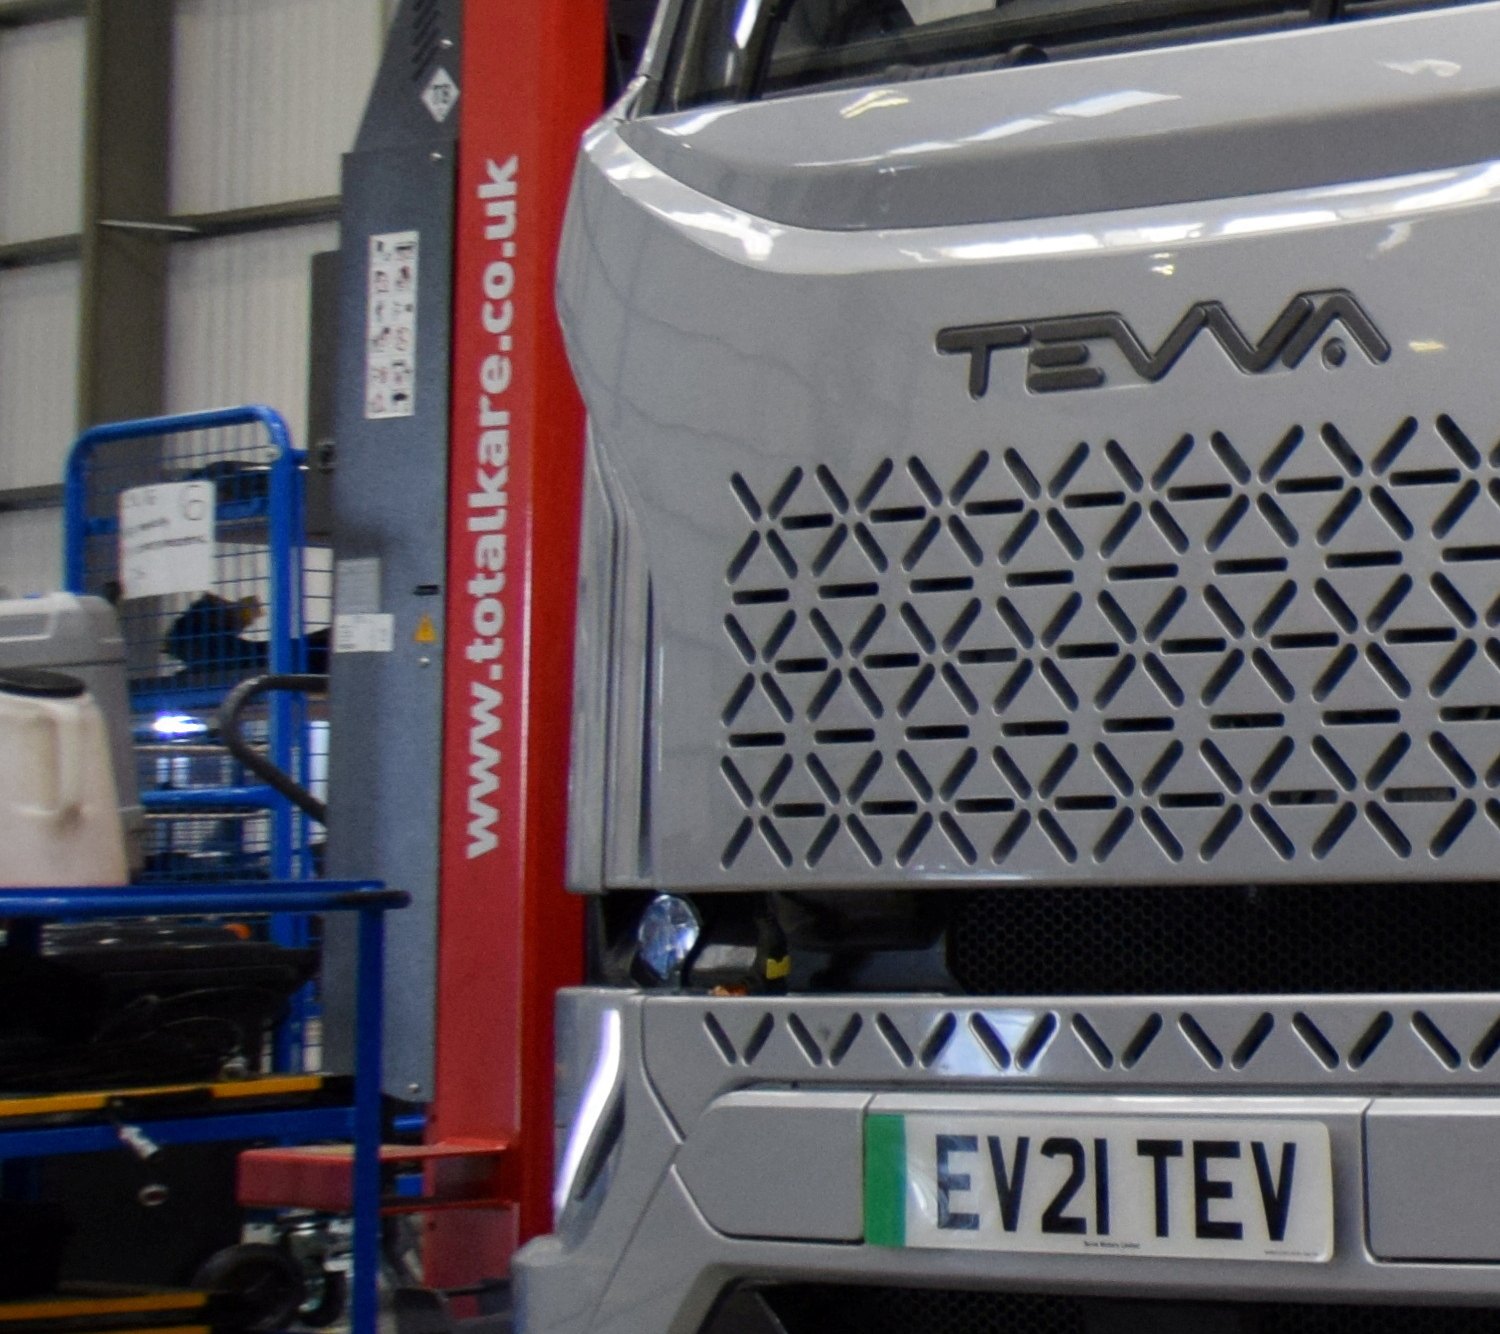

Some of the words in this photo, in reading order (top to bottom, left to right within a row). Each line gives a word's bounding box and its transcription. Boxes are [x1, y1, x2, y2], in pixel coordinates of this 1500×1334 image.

[935, 287, 1393, 401] TEVVA
[466, 153, 519, 860] www.totalkare.co.uk
[936, 1133, 1110, 1237] EV21
[1136, 1138, 1297, 1242] TEV
